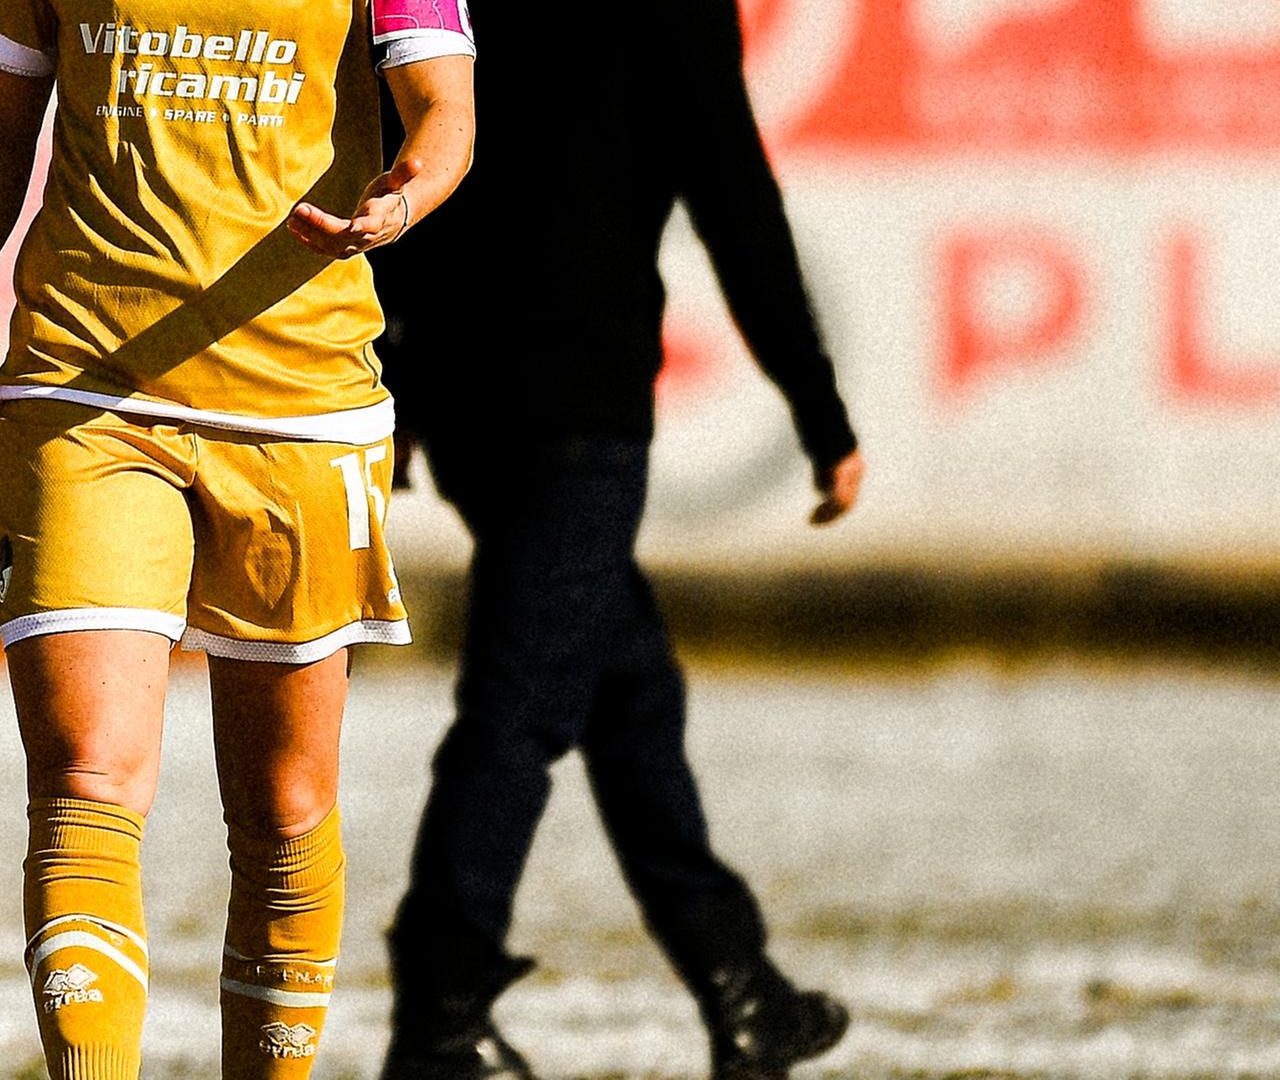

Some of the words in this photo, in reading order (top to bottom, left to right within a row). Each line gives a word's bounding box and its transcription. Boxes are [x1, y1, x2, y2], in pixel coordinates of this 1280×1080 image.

[79, 23, 297, 64] Vitobello
[118, 63, 306, 104] ricambi
[95, 105, 143, 118] ENGINE
[163, 108, 217, 124] SPARE
